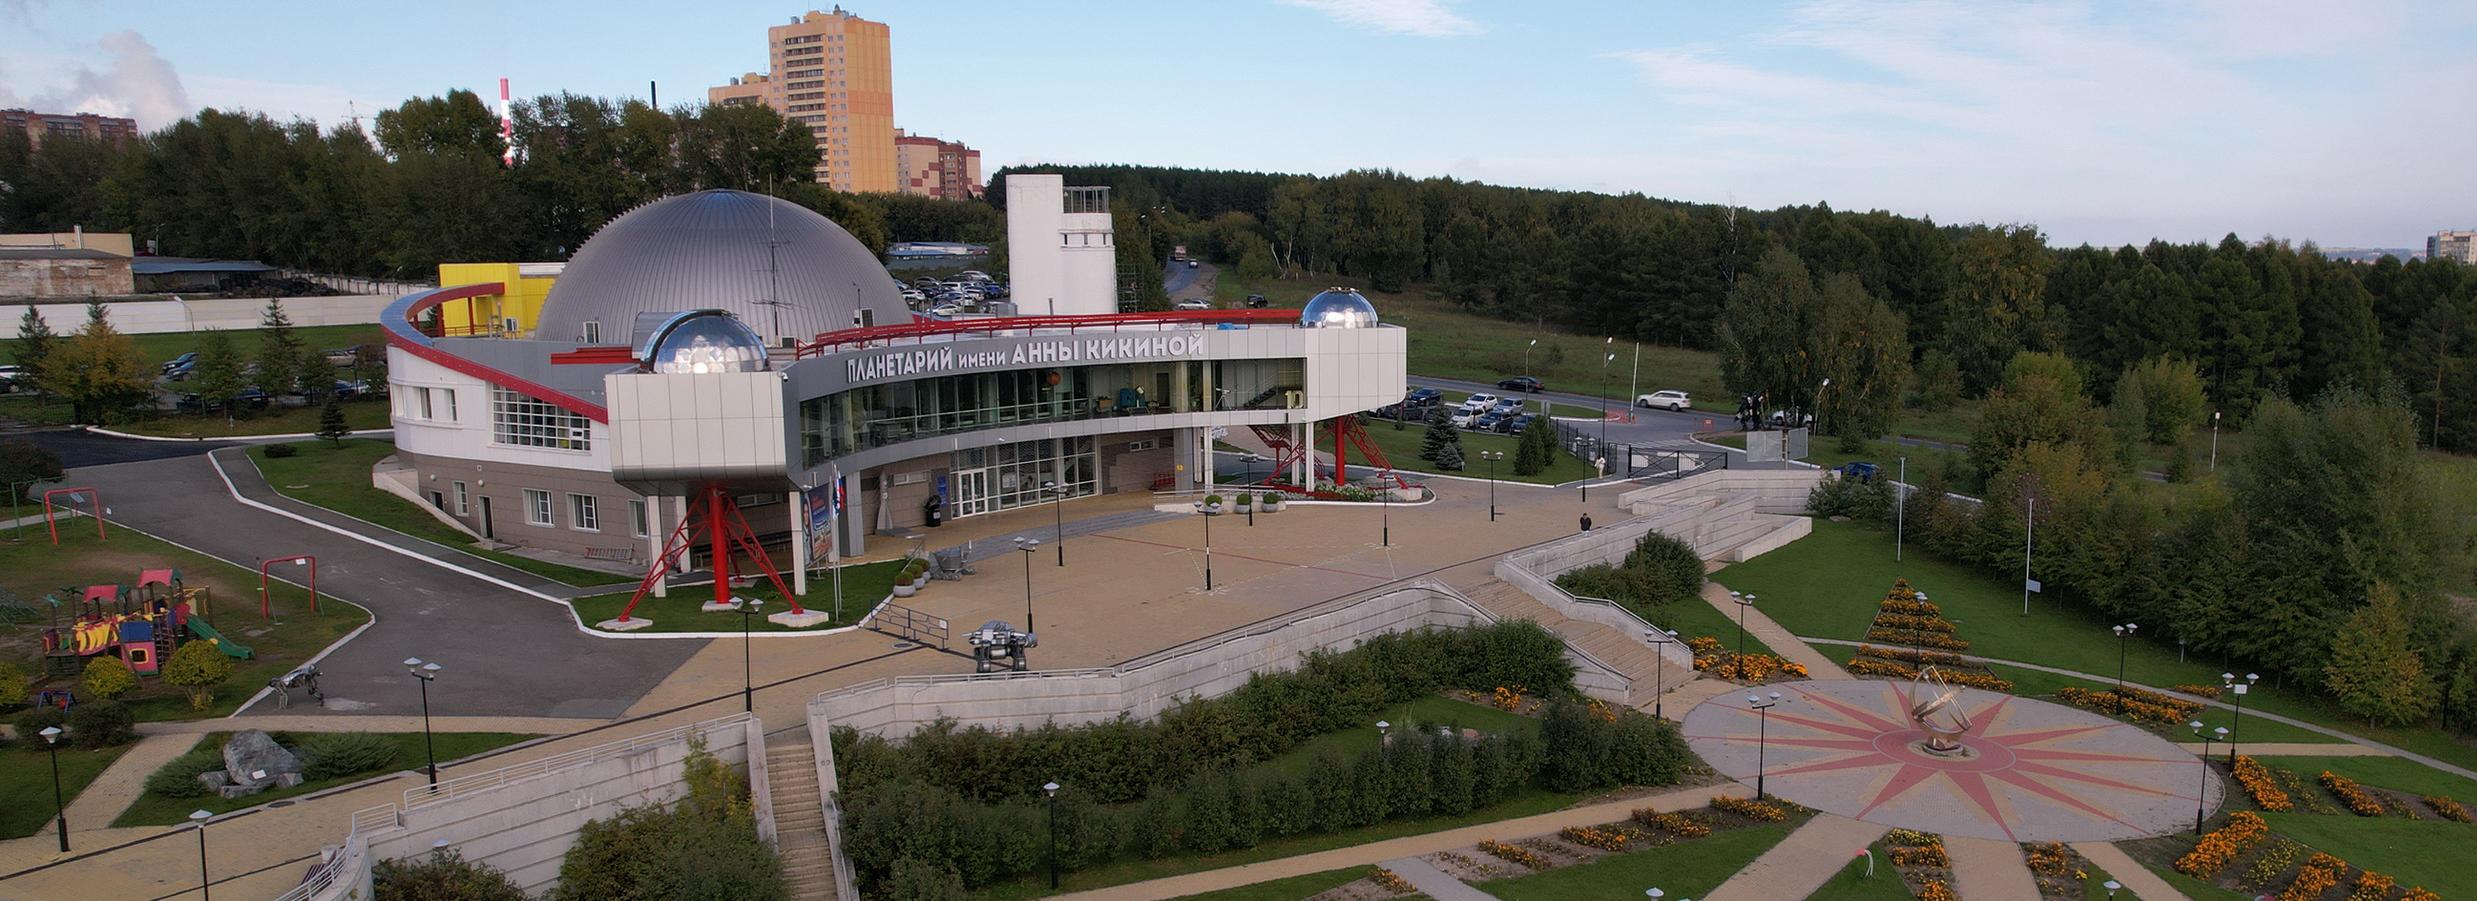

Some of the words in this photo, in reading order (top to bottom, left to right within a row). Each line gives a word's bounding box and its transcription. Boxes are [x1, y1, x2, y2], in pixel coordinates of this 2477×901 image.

[847, 346, 953, 383] ПЛАНЕТАРИЙ
[958, 351, 1006, 369] ИМЕНИ
[1011, 340, 1079, 365] АННЫ
[1085, 333, 1205, 360] КИКИНОЙ
